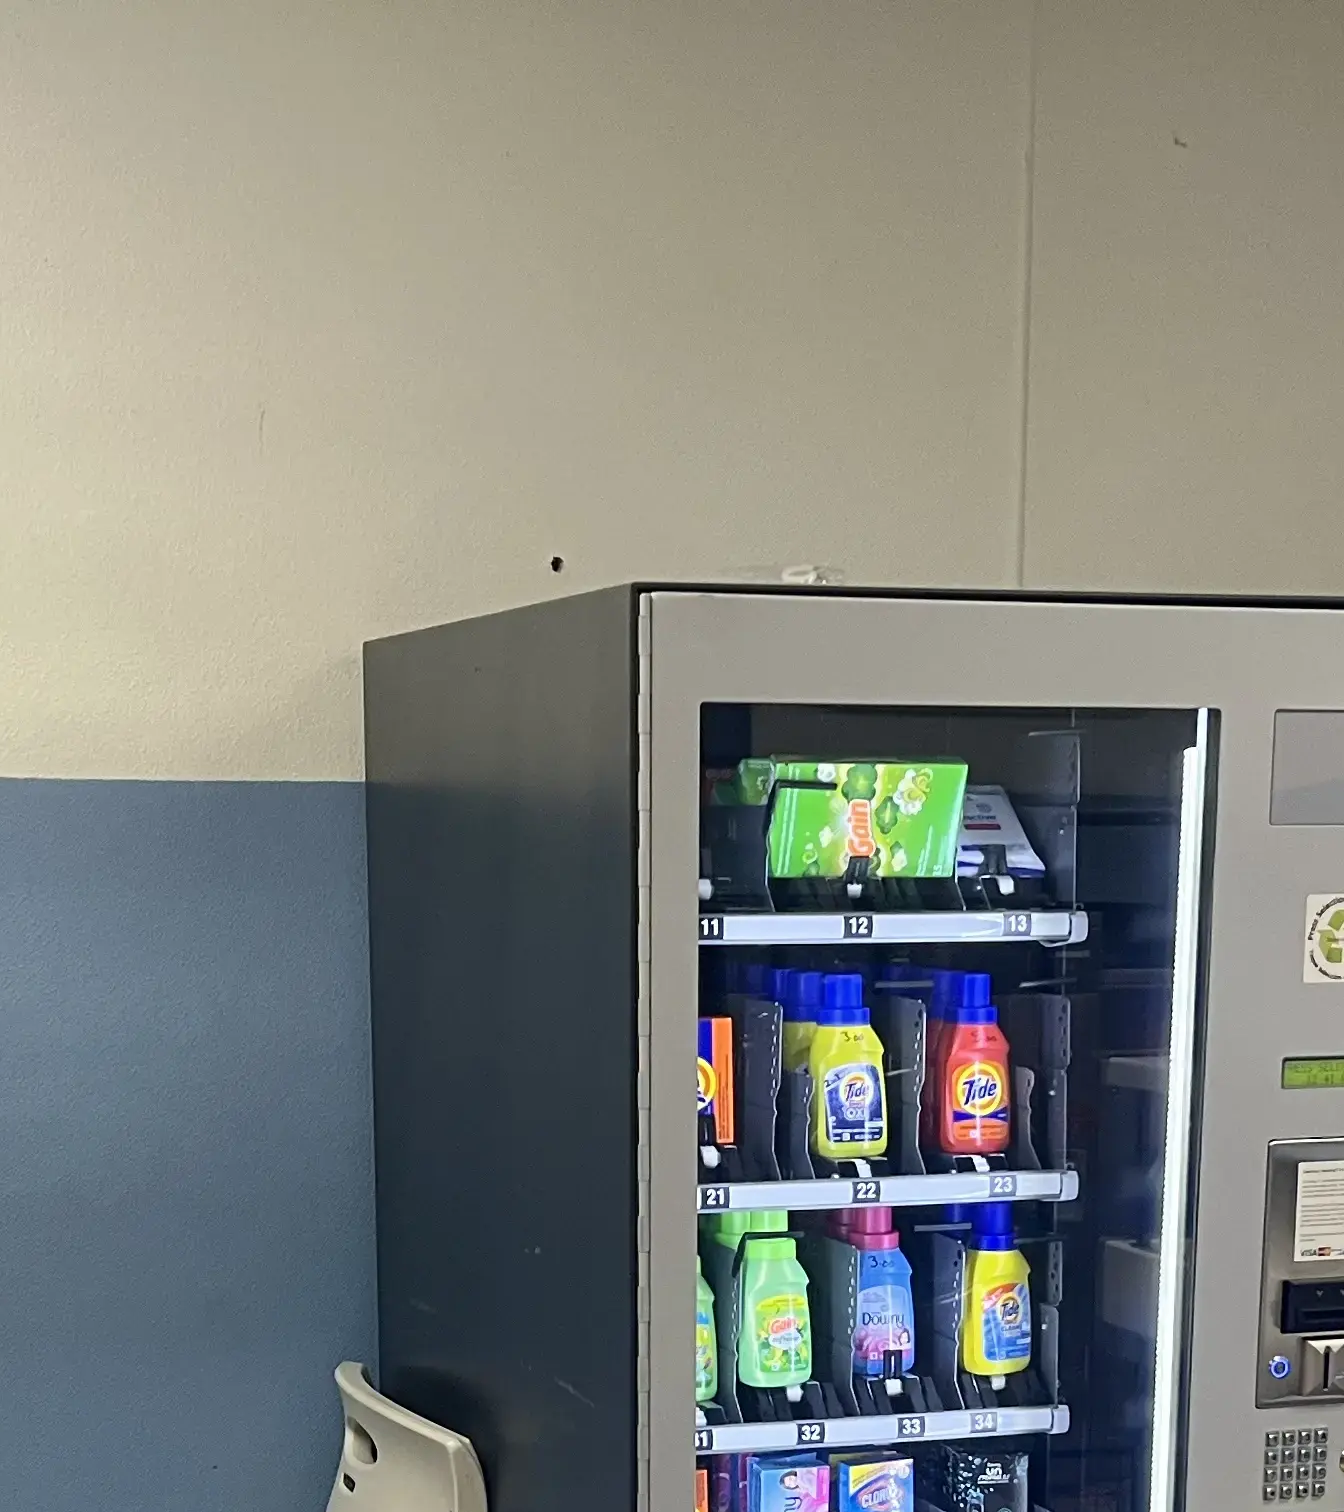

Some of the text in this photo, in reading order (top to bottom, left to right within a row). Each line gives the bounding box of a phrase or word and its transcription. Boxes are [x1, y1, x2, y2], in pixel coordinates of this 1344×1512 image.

[847, 799, 876, 857] Gain
[700, 919, 719, 936] 11
[848, 916, 869, 934] 12
[1008, 915, 1027, 932] 13
[845, 1082, 870, 1102] Tide
[962, 1077, 997, 1106] Tide
[856, 1182, 876, 1199] 22
[993, 1177, 1013, 1193] 23
[706, 1188, 725, 1205] 21
[862, 1312, 905, 1328] Downy
[902, 1418, 921, 1435] 33
[974, 1414, 994, 1430] 34
[801, 1425, 821, 1441] 32
